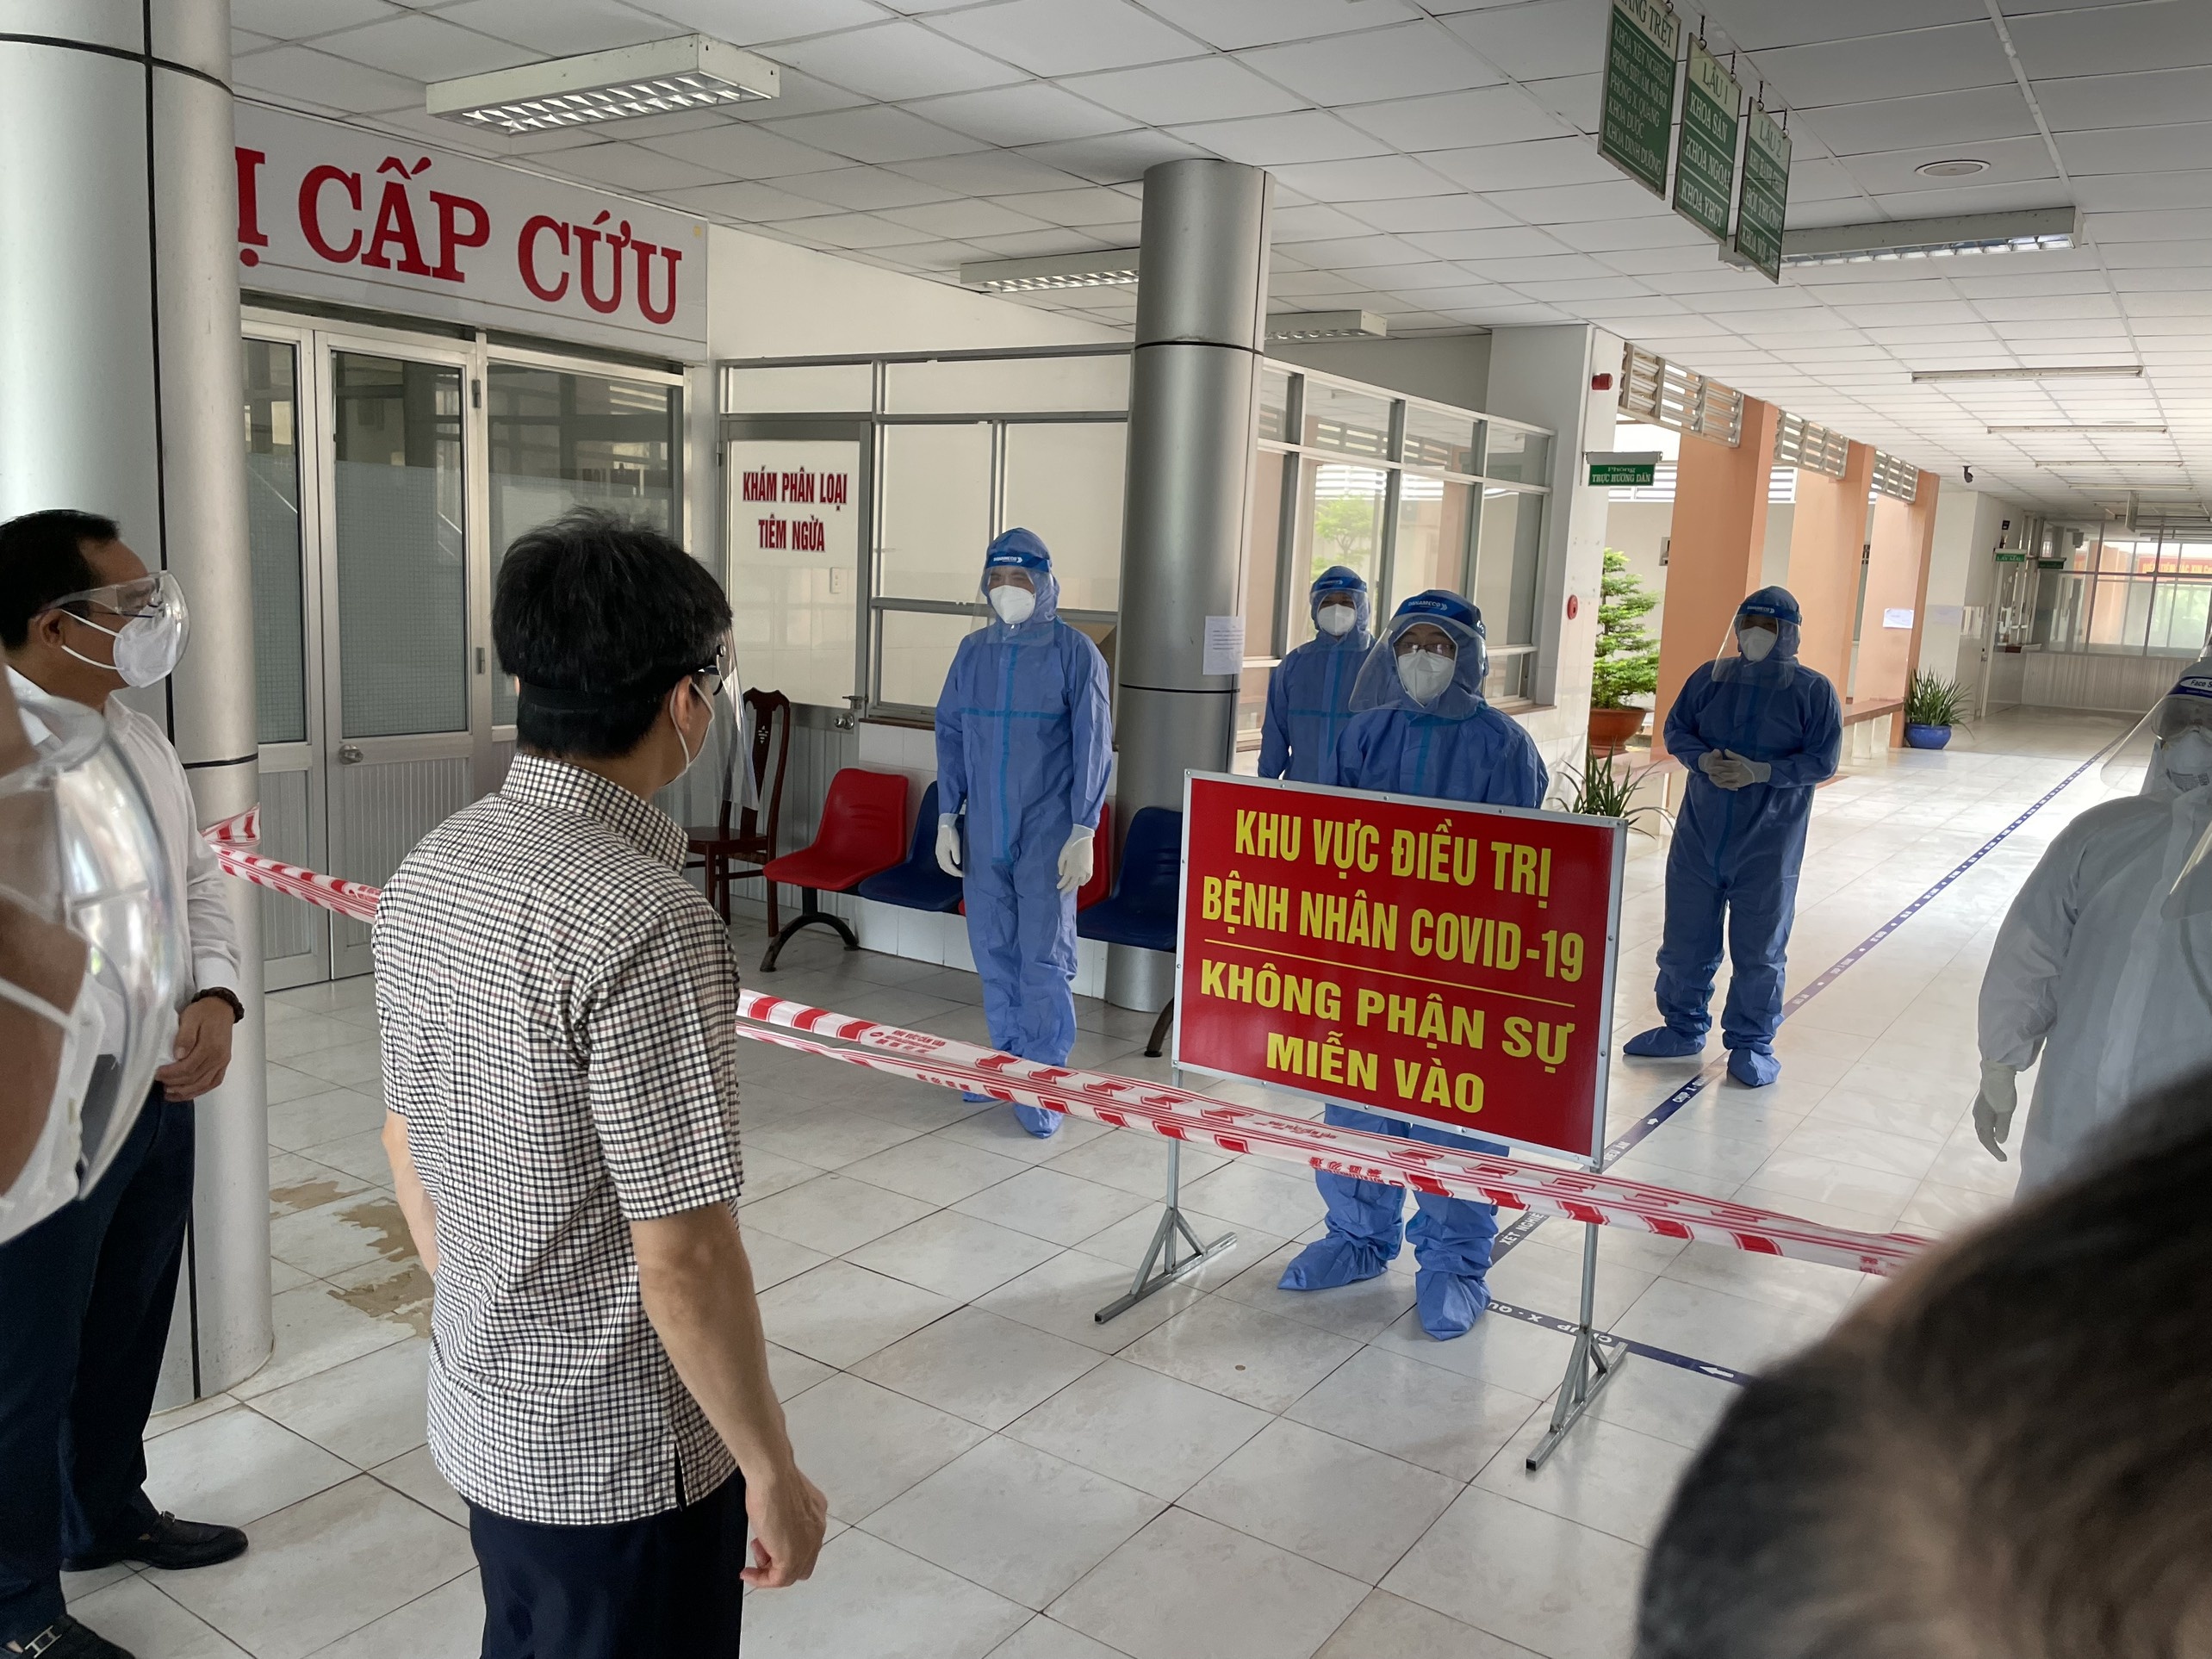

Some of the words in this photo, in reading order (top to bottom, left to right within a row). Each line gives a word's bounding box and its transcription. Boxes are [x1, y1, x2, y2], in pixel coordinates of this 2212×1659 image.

[1650, 5, 1674, 48] TRỆT
[1613, 22, 1631, 53] KHOA
[1632, 38, 1645, 66] XÉT
[1646, 53, 1670, 88] NGHIỆM
[1606, 120, 1625, 147] KHOA
[1607, 96, 1626, 124] KHOA
[1626, 109, 1644, 142] DƯỢC
[1637, 96, 1661, 130] QUANG
[1689, 90, 1712, 131] KHOA
[1712, 110, 1729, 144] SẢN
[1685, 133, 1707, 172] KHOA
[1707, 152, 1730, 196] NGOẠI
[1776, 139, 1783, 159] 2
[1681, 177, 1703, 214] KHOA
[1703, 195, 1723, 229] YHCT
[1744, 182, 1757, 218] HỘI
[298, 157, 490, 283] CẤP
[518, 210, 682, 325] CỨU
[743, 465, 777, 501] KHÁM
[781, 466, 815, 504] PHÂN
[819, 473, 848, 511] LOẠI
[1592, 474, 1610, 483] TRỰC
[1637, 472, 1651, 482] DẪN
[758, 513, 786, 550] TIÊM
[792, 514, 825, 552] NGỪA
[1235, 810, 1302, 862] KHU
[1313, 818, 1380, 879] VỰC
[1391, 818, 1478, 886] ĐIỀU
[1491, 841, 1552, 909] TRỊ
[1202, 871, 1289, 934] BỆNH
[1299, 889, 1398, 952] NHÂN
[1410, 908, 1584, 983] COVID-19
[1201, 959, 1341, 1022] KHÔNG
[1357, 992, 1484, 1050] PHẬN
[1501, 1016, 1575, 1073] SỰ
[1266, 1031, 1378, 1091] MIỄN
[1394, 1057, 1485, 1114] VÀO
[1499, 1231, 1521, 1246] XÉT
[1515, 1212, 1549, 1232] NGHIỆ
[1527, 1313, 1543, 1323] X
